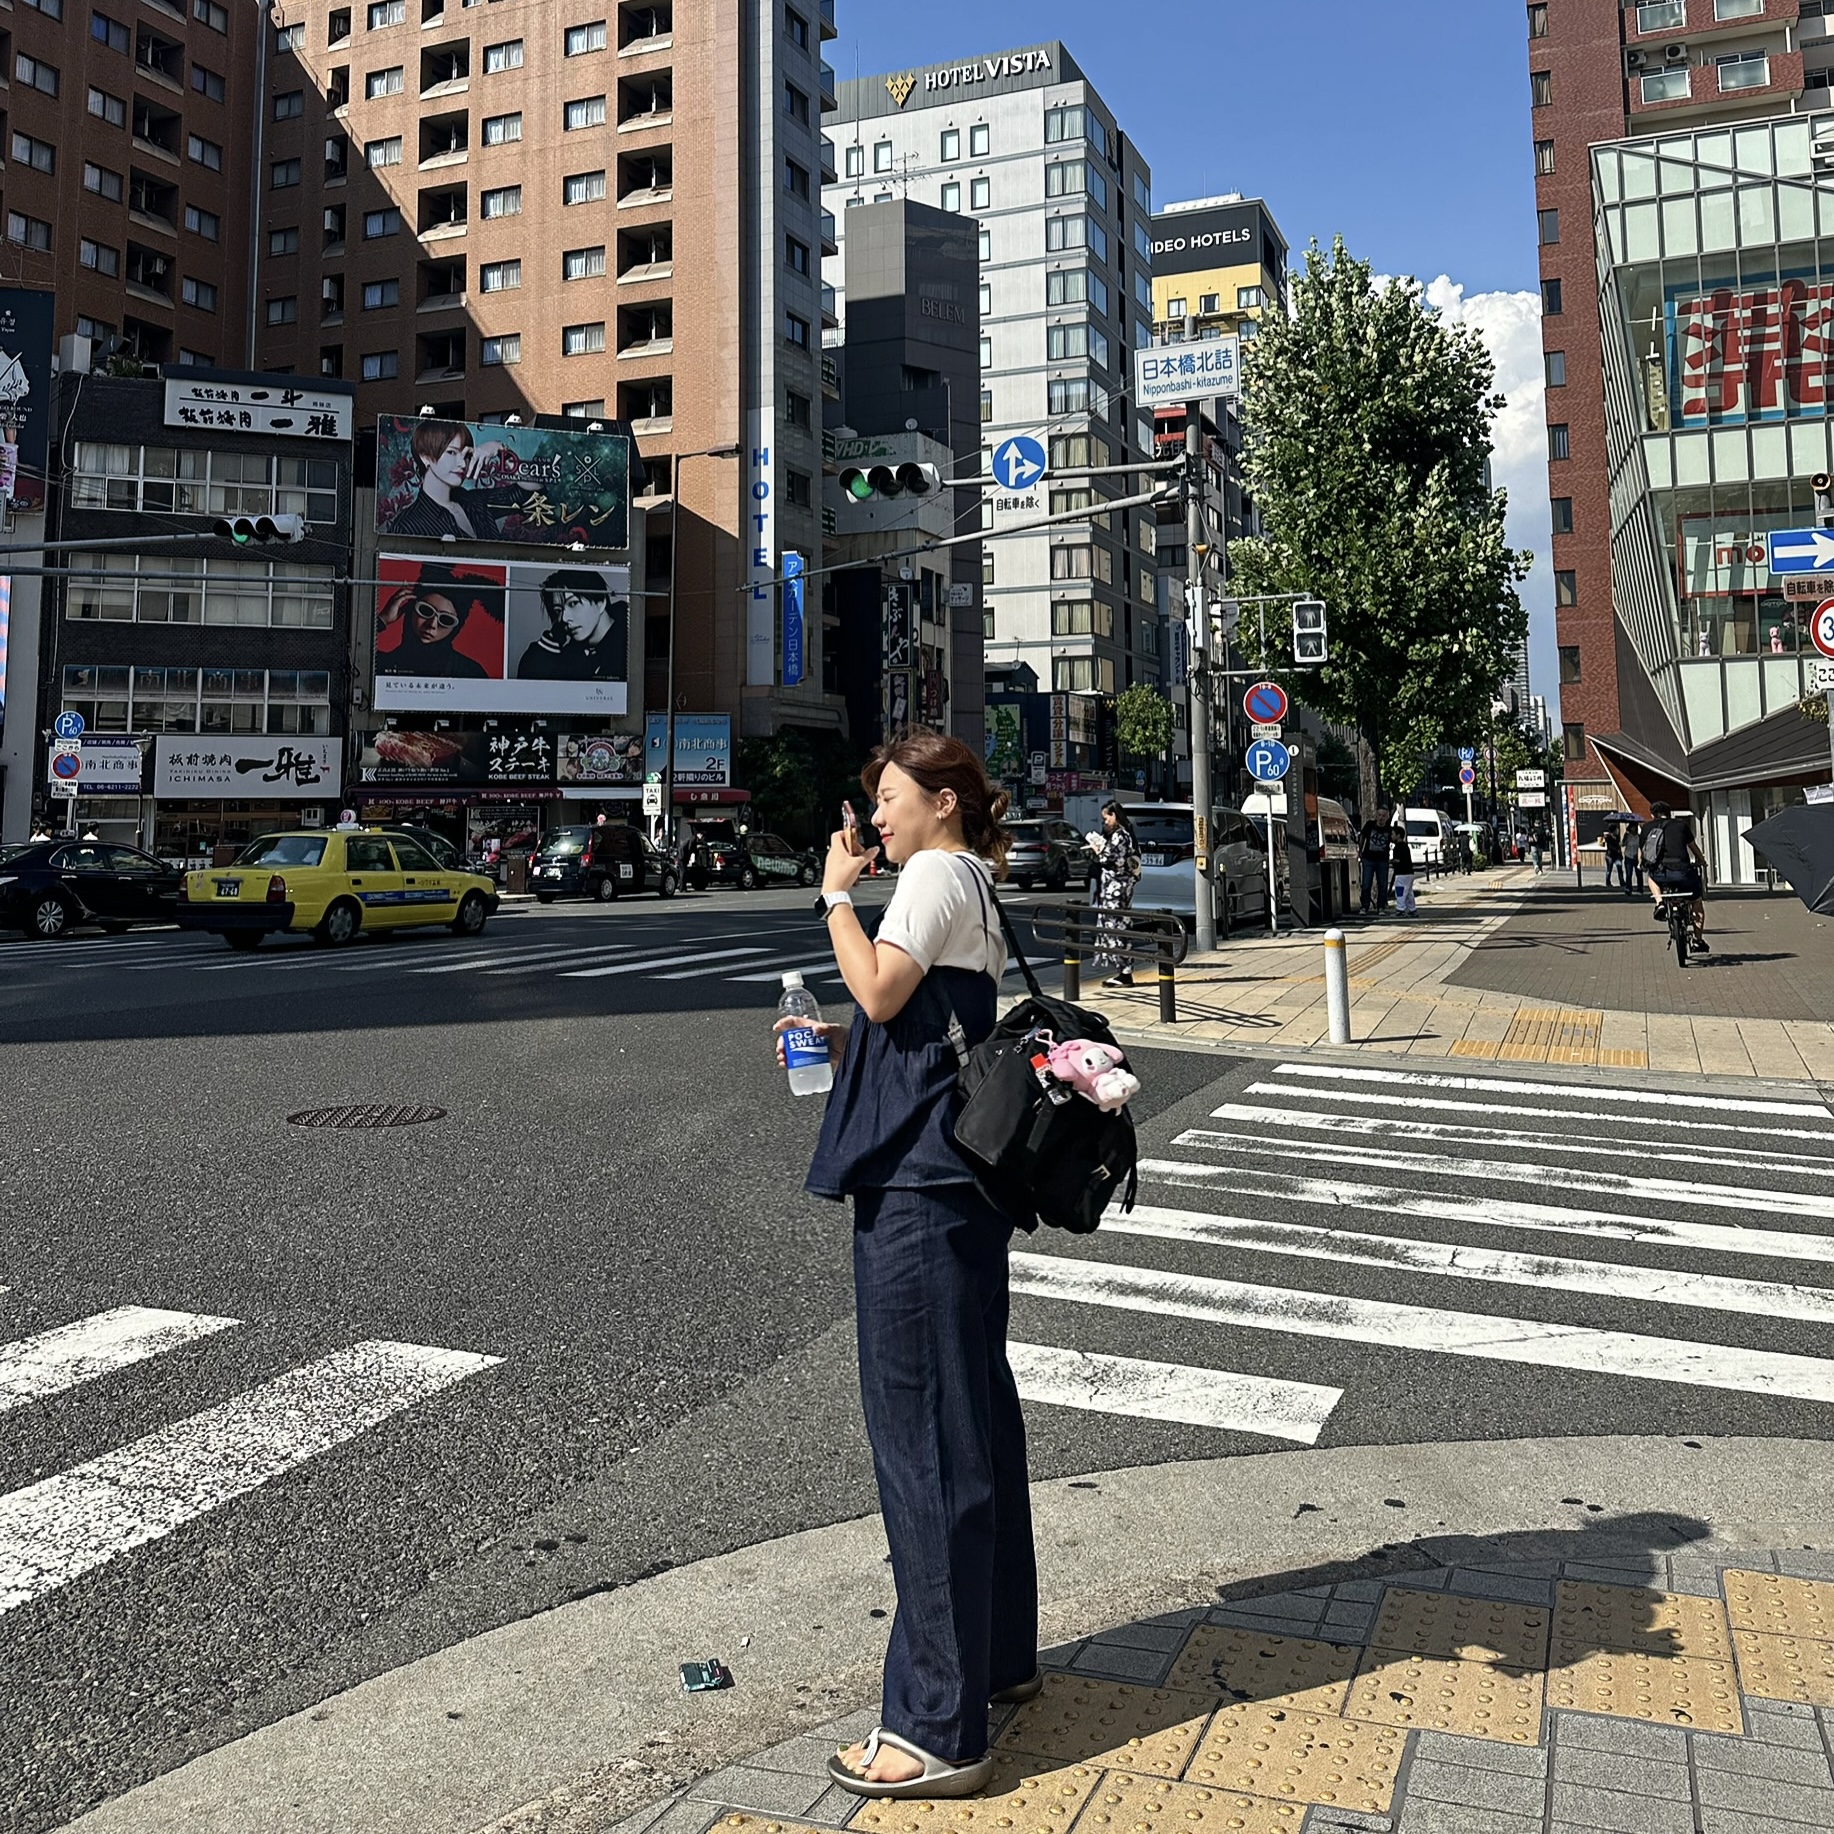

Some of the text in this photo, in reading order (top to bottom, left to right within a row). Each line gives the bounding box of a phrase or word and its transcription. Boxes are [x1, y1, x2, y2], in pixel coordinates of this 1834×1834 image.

[925, 49, 1051, 91] HOTEL VISTA
[1190, 227, 1251, 249] HOTELS
[921, 297, 965, 326] BELEM
[1143, 347, 1233, 381] 日本橋北詰
[1143, 373, 1233, 397] Nipponbashi-kitazume
[500, 449, 562, 479] Dear's
[487, 491, 615, 527] 一条レン
[996, 495, 1040, 511] 自転車を除く
[752, 447, 769, 600] HOTEL
[61, 717, 74, 735] P
[69, 727, 78, 735] 60
[489, 735, 551, 757] 神戸牛
[168, 752, 232, 767] 板前焼肉
[234, 746, 321, 787] 一雅
[488, 757, 551, 773] ステーキ
[705, 756, 725, 770] 2F
[1255, 750, 1272, 777] P
[1267, 763, 1280, 777] 60
[169, 775, 231, 783] ICHIMASA
[757, 856, 798, 876] newmo
[788, 1031, 816, 1042] POC
